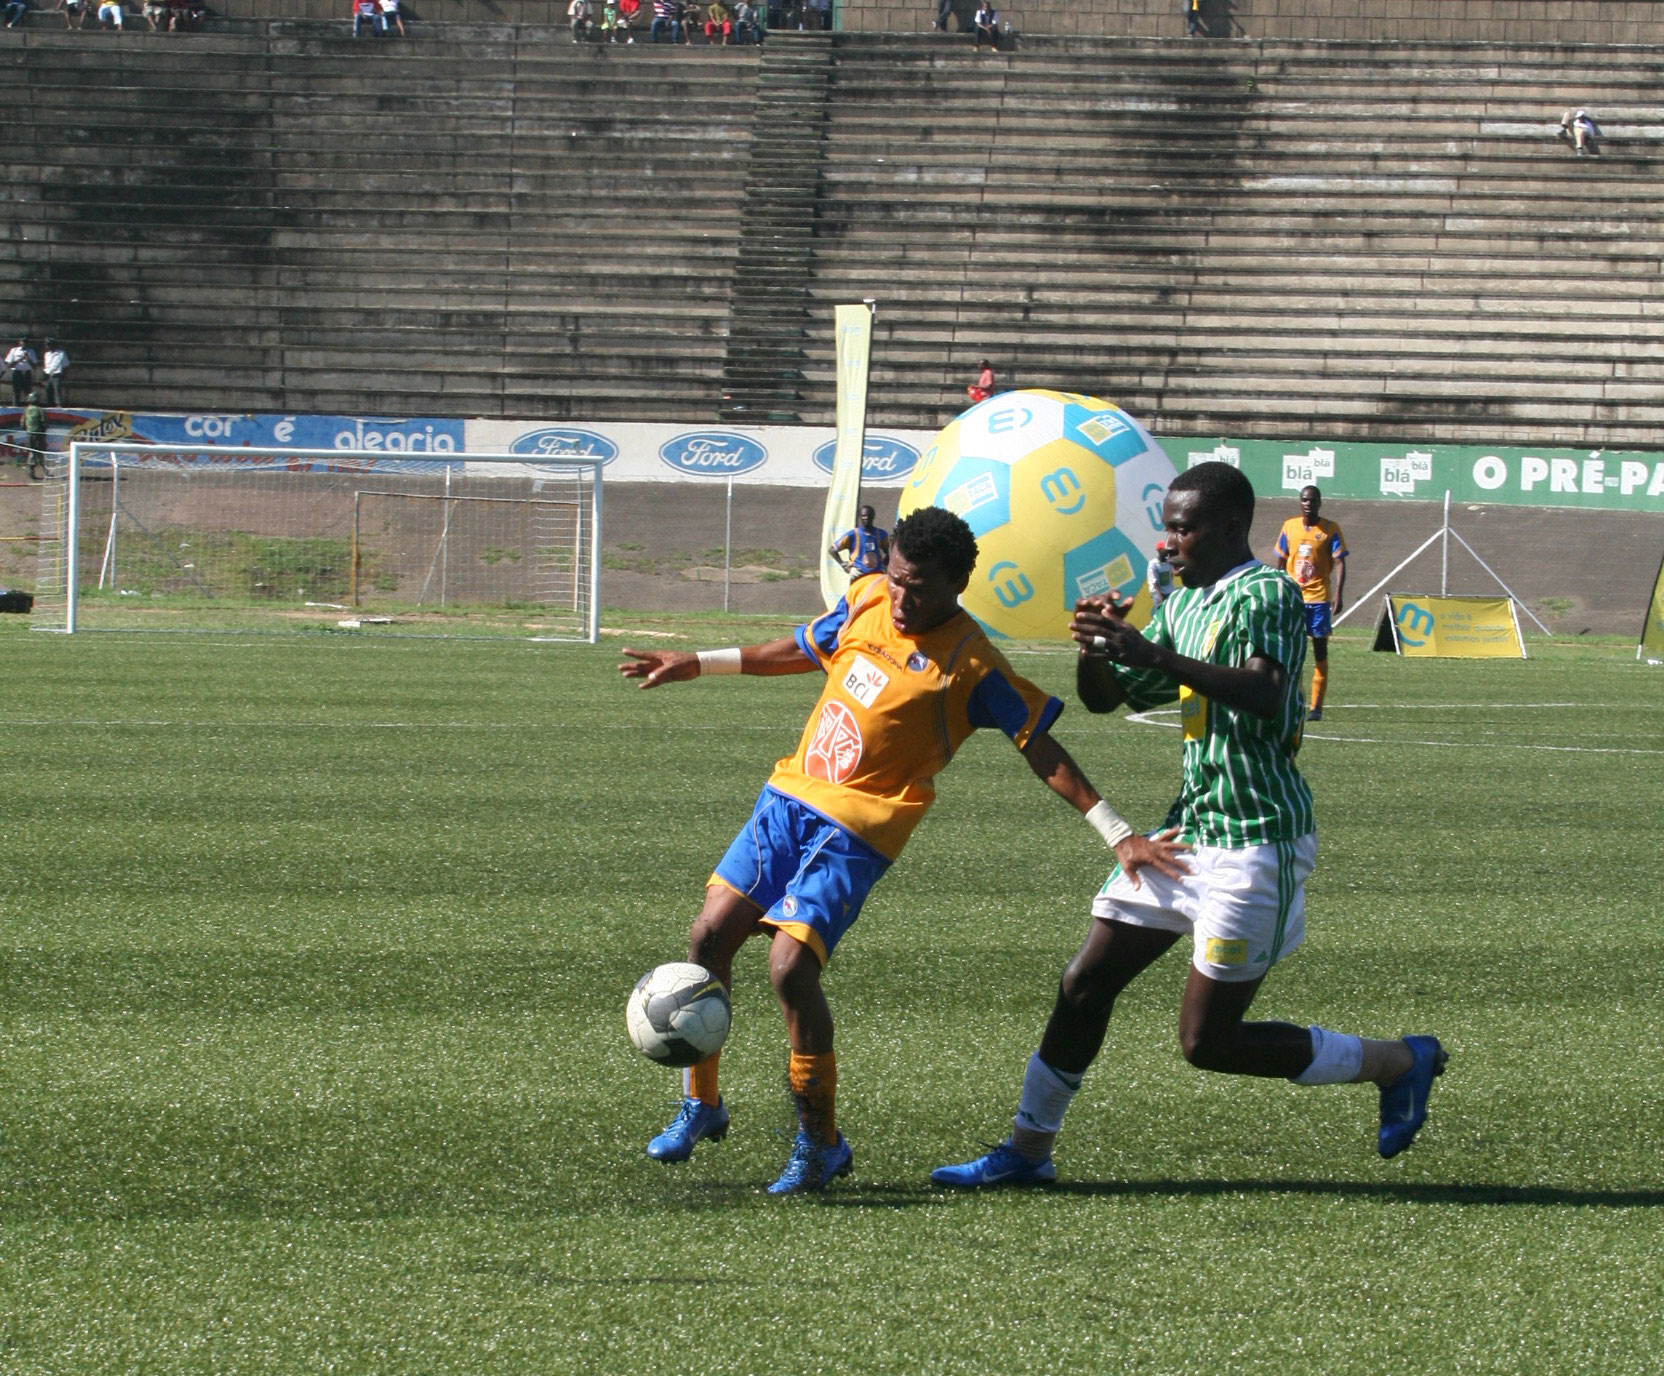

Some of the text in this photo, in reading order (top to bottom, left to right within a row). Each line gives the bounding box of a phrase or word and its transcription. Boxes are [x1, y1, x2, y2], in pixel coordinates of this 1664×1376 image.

[185, 416, 242, 437] cor
[274, 416, 297, 443] é
[680, 438, 745, 467] Ford
[862, 446, 898, 471] rd
[1313, 457, 1331, 468] blá
[1286, 465, 1313, 480] blá
[1384, 468, 1411, 483] blá
[1412, 461, 1429, 471] blá
[1472, 455, 1507, 490] O
[845, 673, 870, 700] BCI
